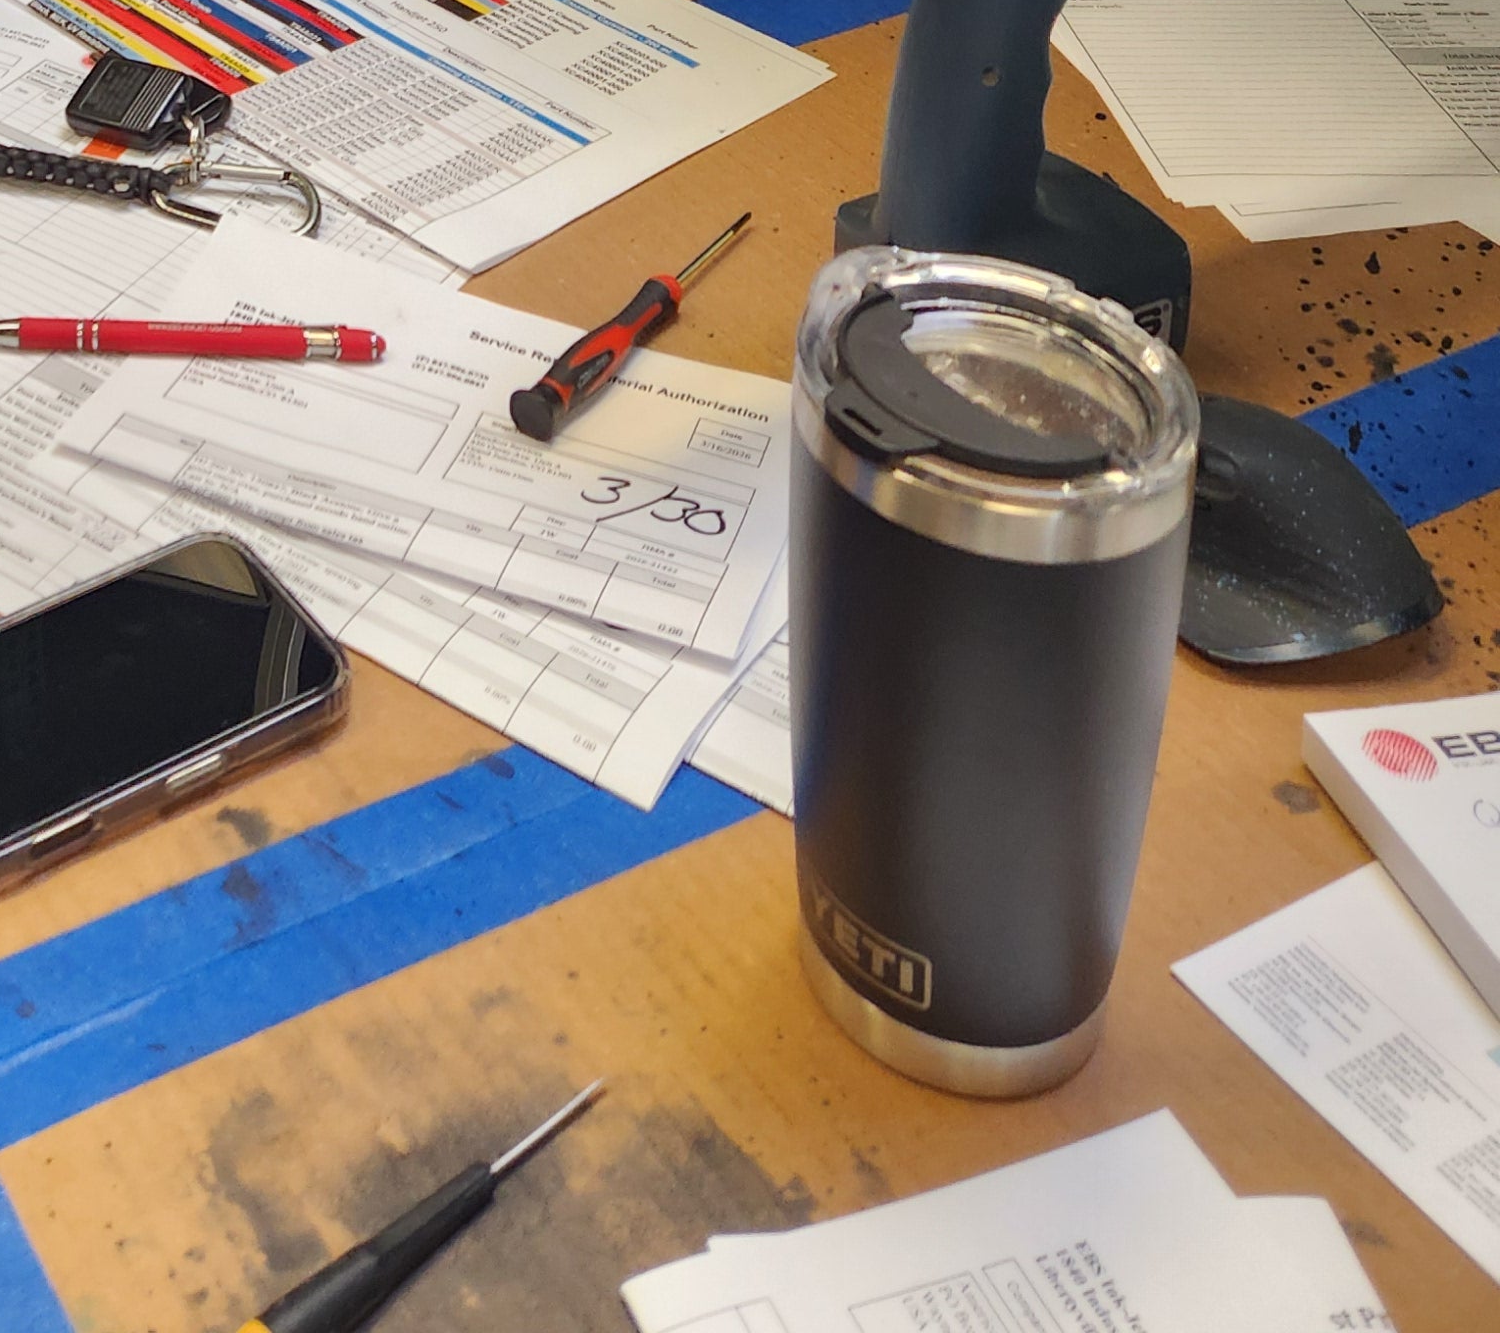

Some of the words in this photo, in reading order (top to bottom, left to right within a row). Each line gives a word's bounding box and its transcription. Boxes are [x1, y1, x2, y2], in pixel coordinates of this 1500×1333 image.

[391, 0, 429, 25] Handjet
[428, 21, 448, 34] 250
[647, 24, 665, 36] Part
[665, 32, 698, 50] Number
[235, 301, 257, 313] EBS
[469, 330, 527, 356] Service
[656, 386, 770, 423] Authorization
[720, 428, 743, 442] Date
[580, 476, 727, 535] 3/30
[658, 623, 683, 638] 0.00
[812, 883, 914, 994] YETI
